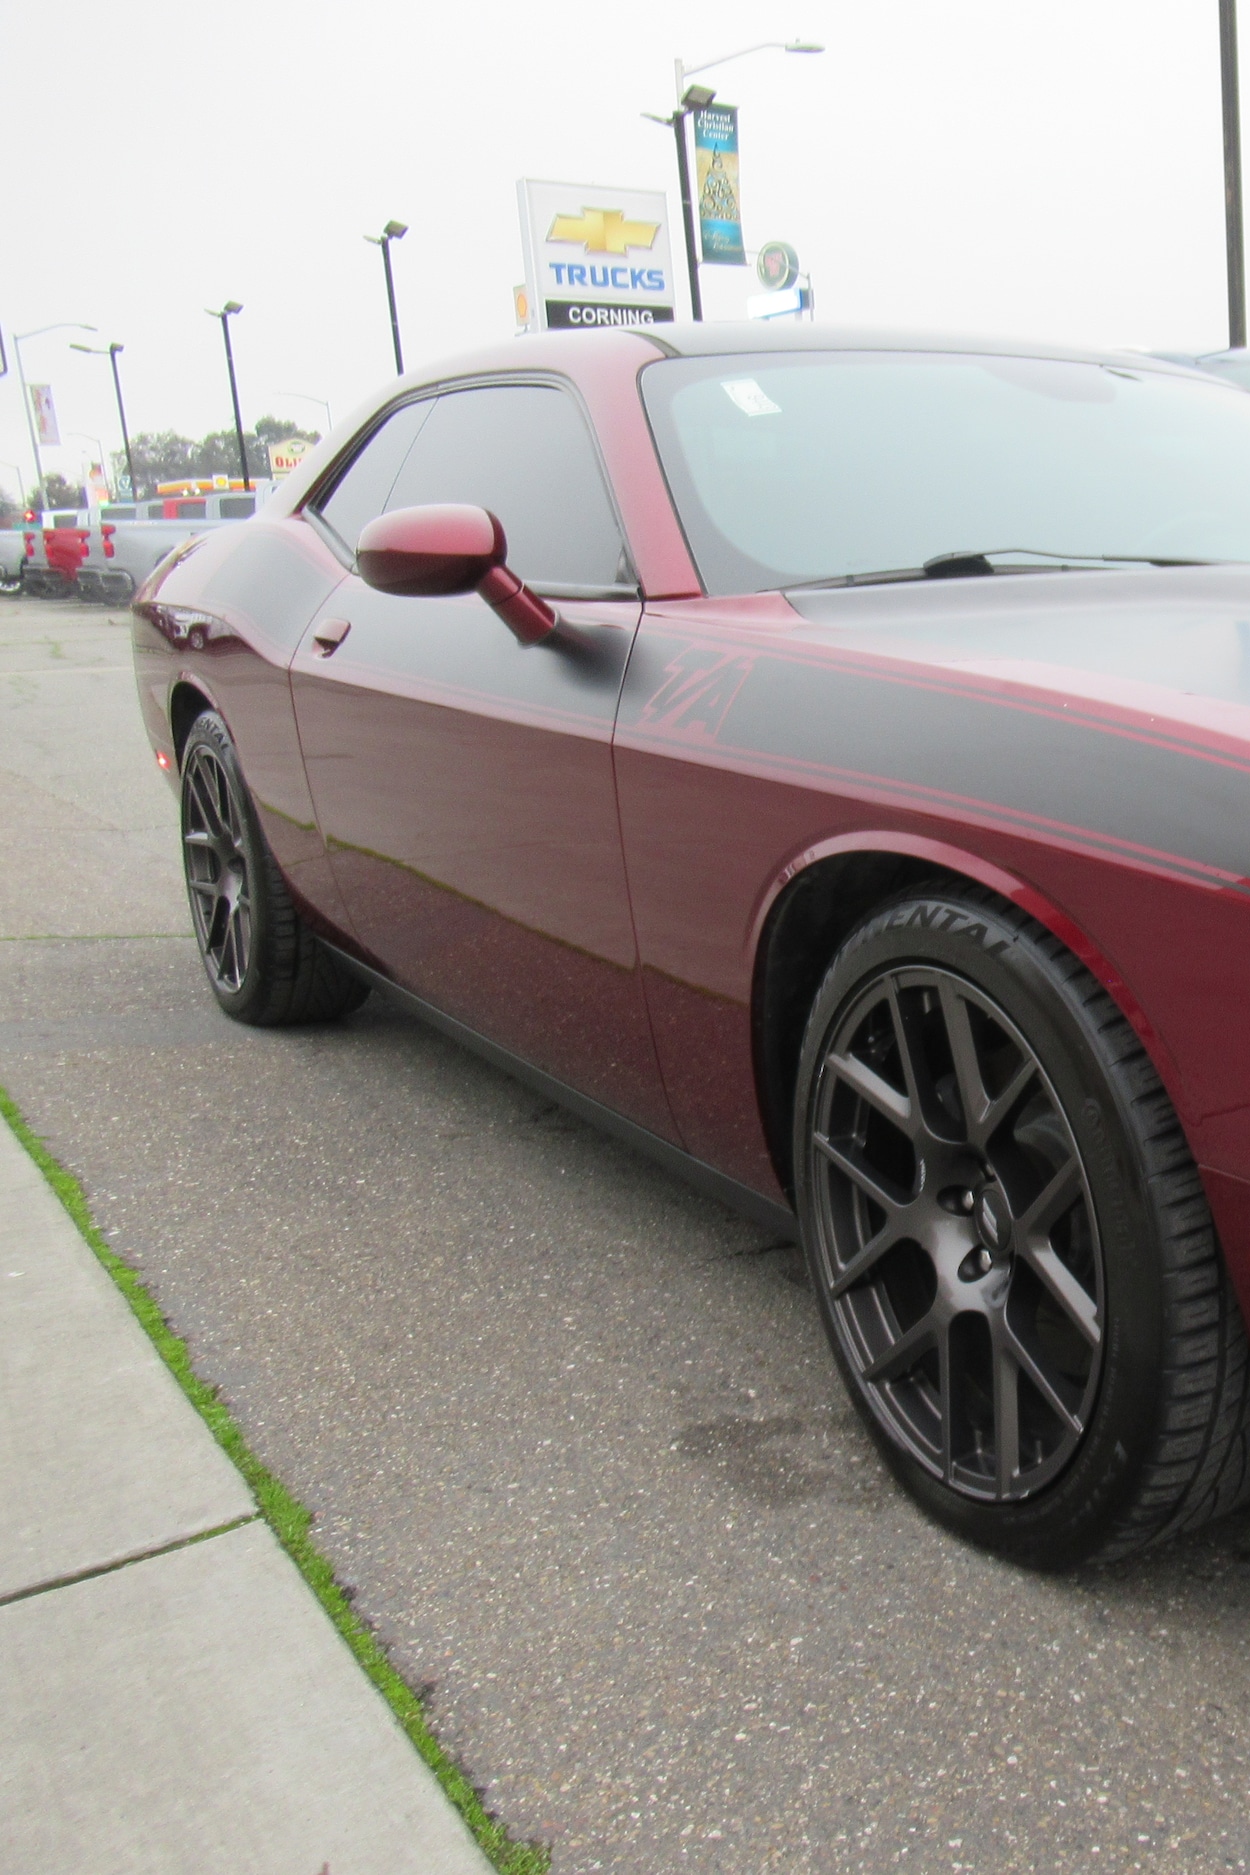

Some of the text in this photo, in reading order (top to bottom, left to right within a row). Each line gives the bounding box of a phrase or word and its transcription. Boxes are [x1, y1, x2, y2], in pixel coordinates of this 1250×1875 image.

[701, 110, 731, 123] Harvest
[698, 118, 734, 132] Christian
[703, 129, 730, 140] Center
[549, 262, 665, 291] TRUCKS
[568, 306, 654, 326] CORNING
